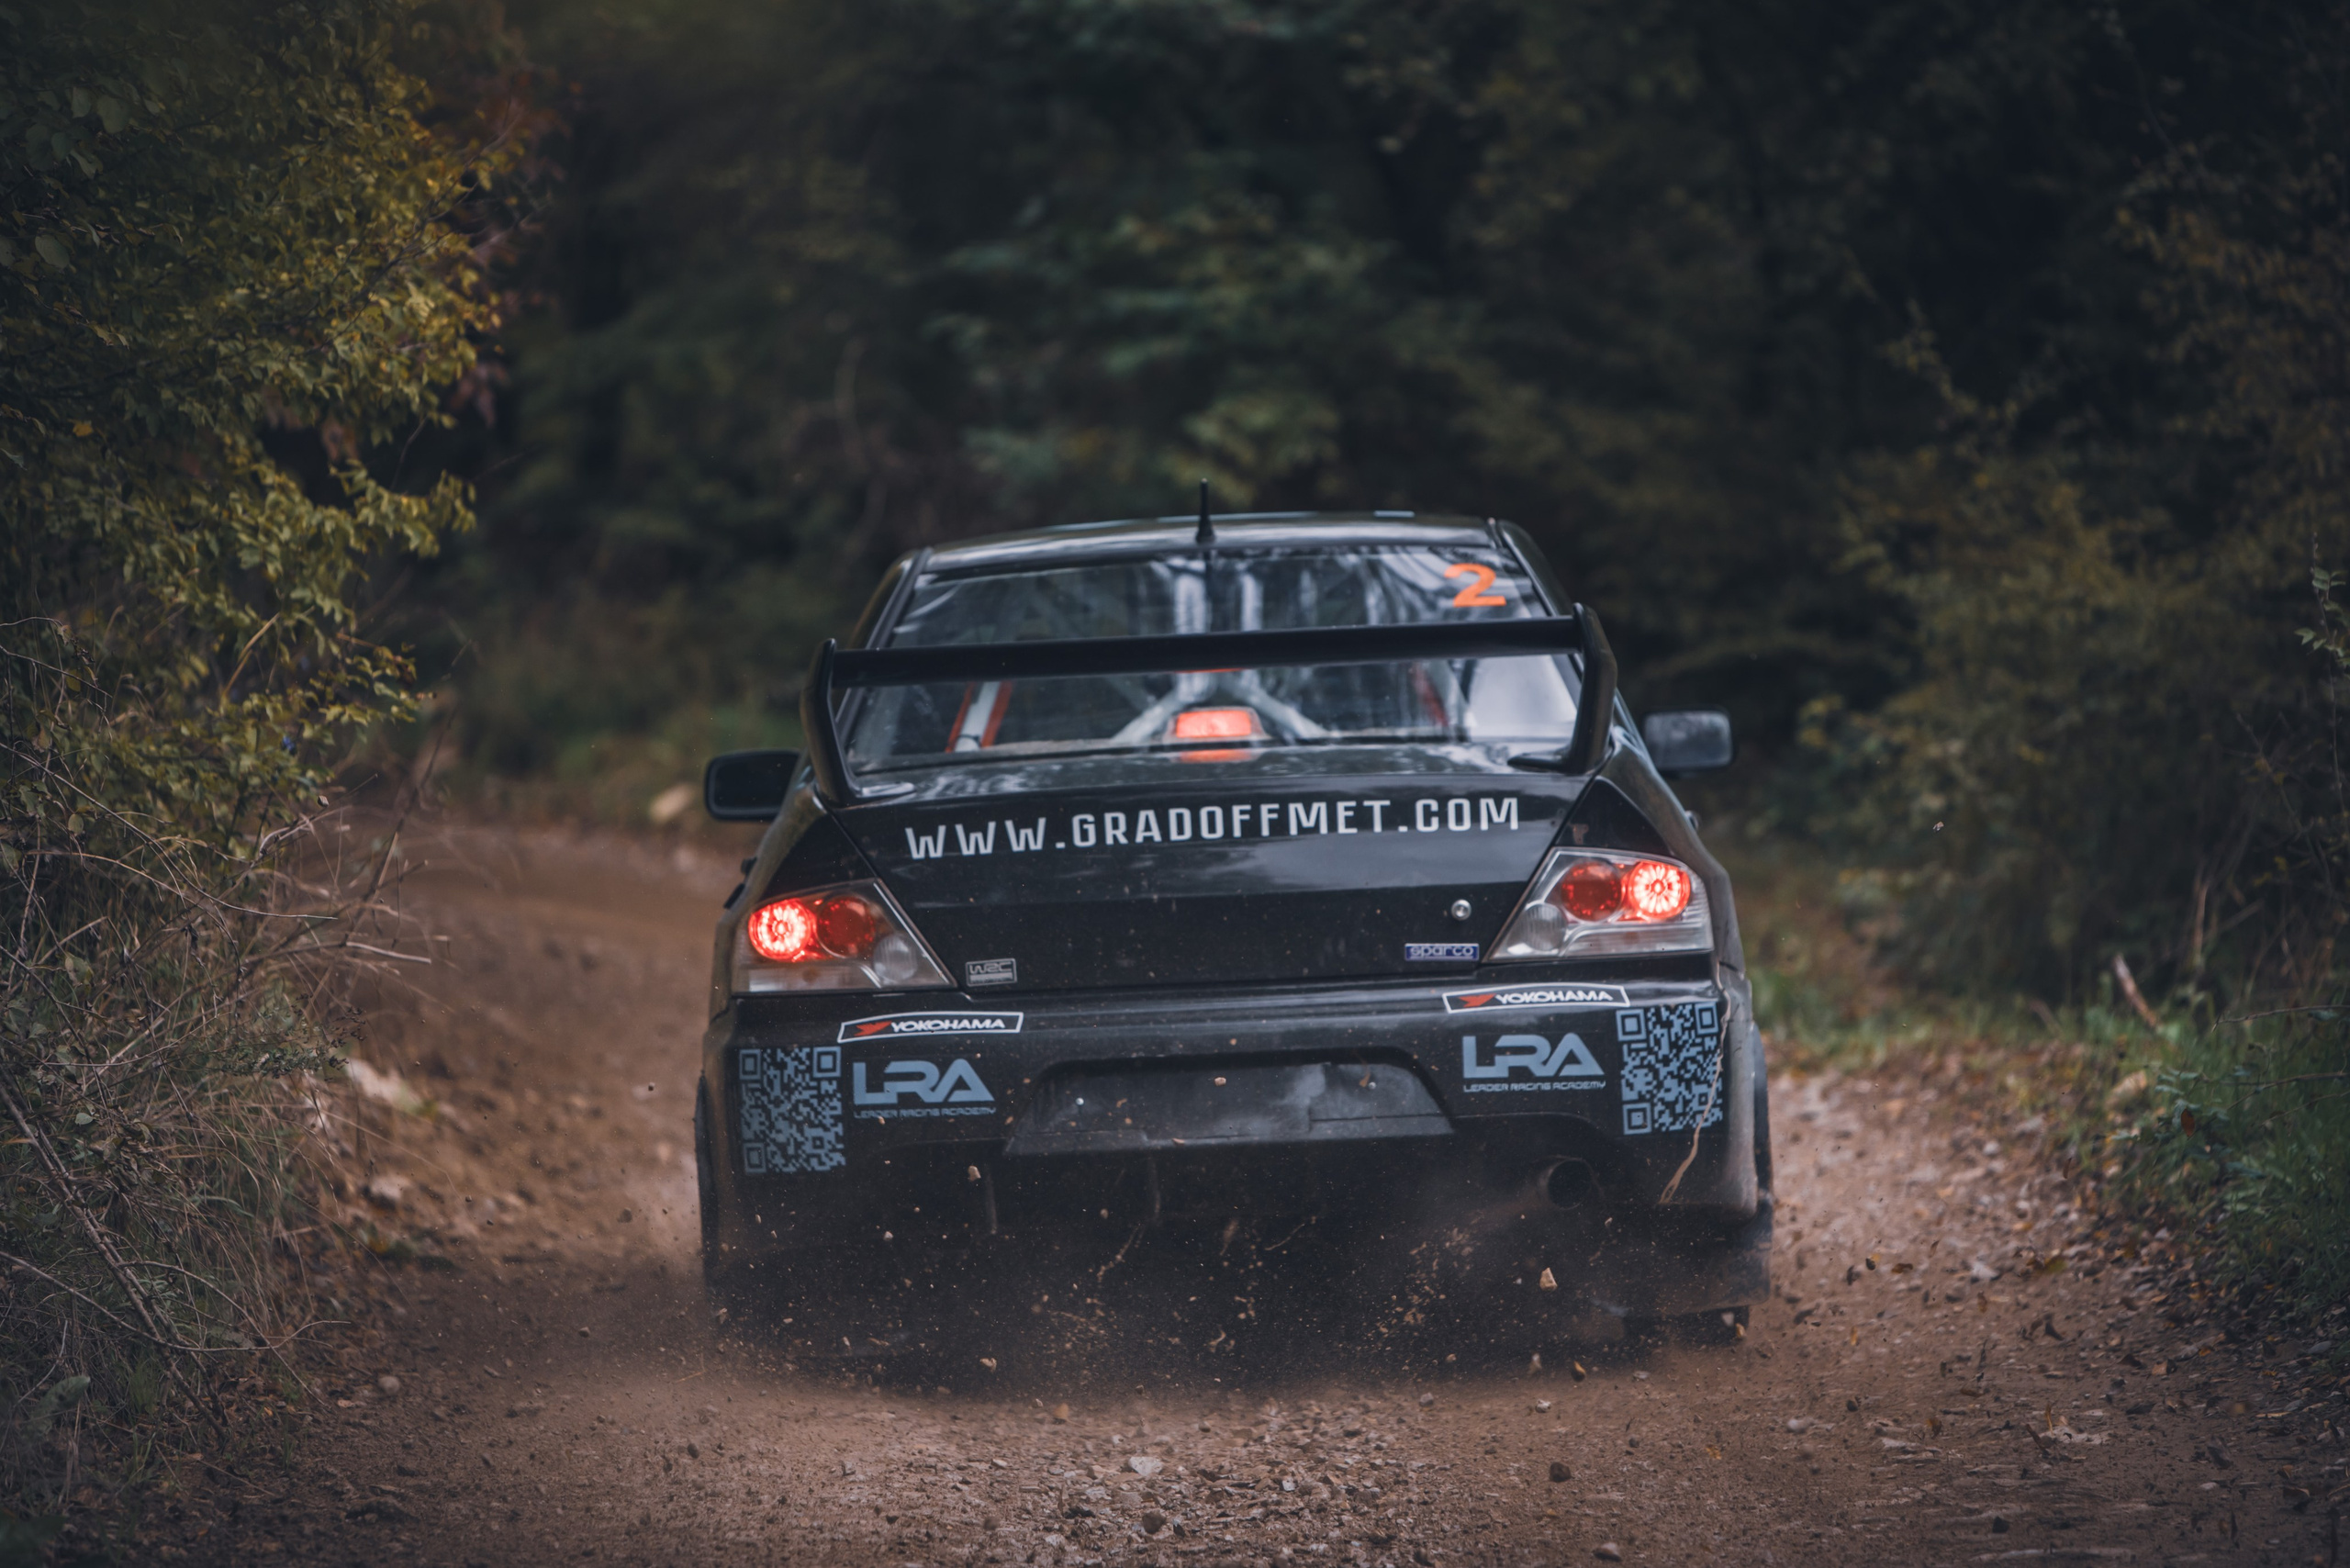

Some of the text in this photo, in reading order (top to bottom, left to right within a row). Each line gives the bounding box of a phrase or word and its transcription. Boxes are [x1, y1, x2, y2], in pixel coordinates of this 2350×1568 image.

[1444, 563, 1506, 608] 2
[905, 798, 1519, 859] WWW.GRADOFFMET.COM
[969, 962, 1012, 973] WRC
[1495, 991, 1613, 1004] YOKOHAMA
[891, 1019, 1005, 1033] YOKOHAMA
[1462, 1033, 1605, 1079] LRA
[853, 1058, 995, 1105] LRA
[1463, 1080, 1606, 1092] LEADER RACING ACADEMY
